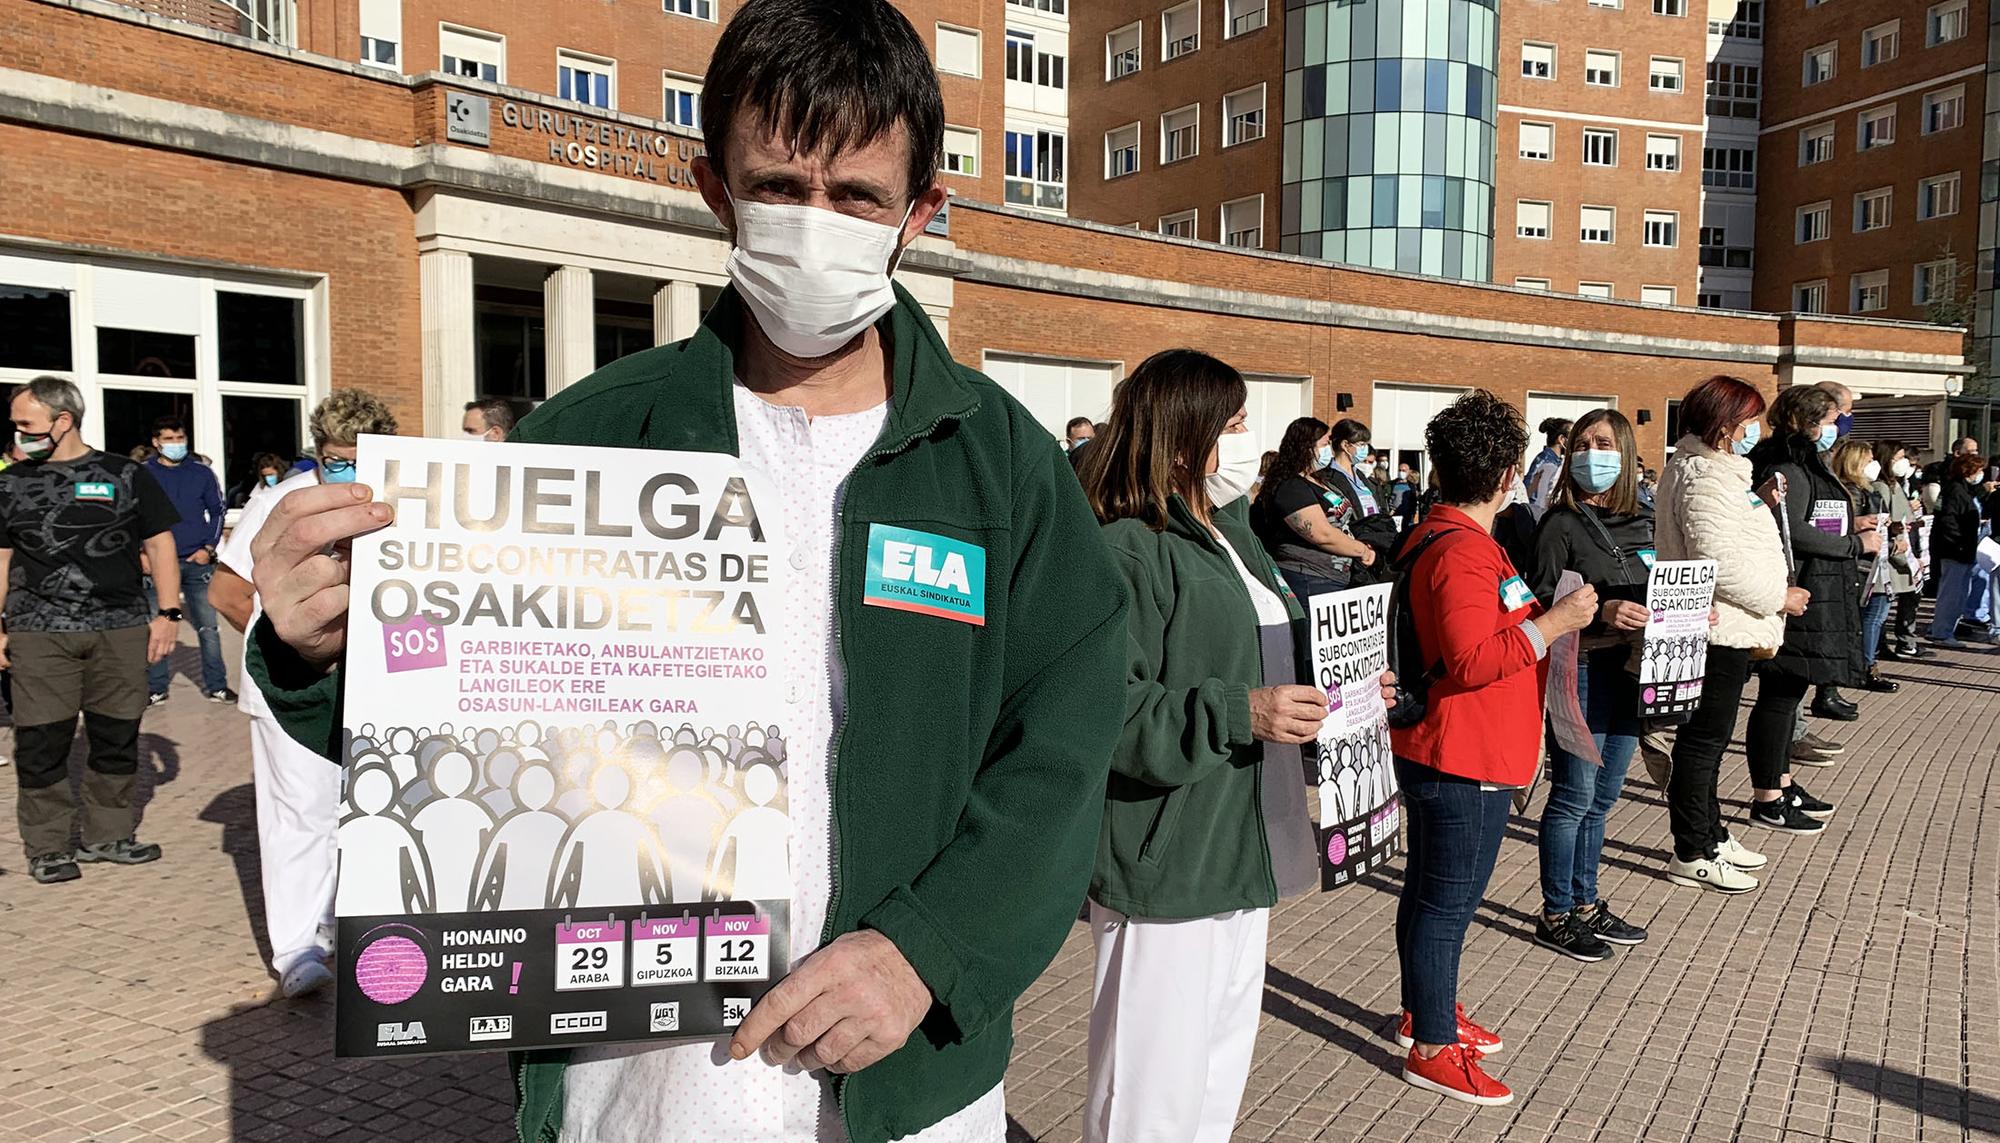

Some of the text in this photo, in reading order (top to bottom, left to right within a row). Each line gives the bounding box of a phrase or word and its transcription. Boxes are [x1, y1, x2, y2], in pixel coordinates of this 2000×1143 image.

[502, 103, 669, 157] GURUTZETAKO
[550, 139, 656, 180] HOSPITAL
[384, 460, 766, 542] HUELGA
[378, 540, 768, 583] SUBCONTRATAS DE
[882, 539, 971, 595] ELA
[1654, 565, 1714, 585] HUELGA
[881, 583, 971, 608] EUSKAL SINDIKATUA
[1652, 586, 1706, 597] SUBCONTRATAS
[371, 579, 766, 634] OSAKIDETZA
[1651, 596, 1710, 611] OSAKIDETZA
[1317, 595, 1384, 642] HUELGA
[390, 625, 439, 657] SOS
[460, 640, 764, 661] GARBIKETAKO, ANBULANTZIETAKO
[1319, 632, 1377, 663] SUBCONTRATAS
[460, 659, 767, 679] ETA SUKALDE ETA KAFETEGIETAKO
[1321, 649, 1385, 690] OSAKIDETZA
[459, 678, 606, 693] LANGILEOK ERE
[458, 697, 698, 713] OSASUN-LANGILEAK GARA
[1328, 687, 1340, 705] SOS
[576, 928, 602, 939] OCT
[652, 924, 677, 936] NOV
[724, 921, 749, 932] NOV
[442, 928, 526, 946] HONAINO
[442, 952, 504, 969] HELDU
[571, 947, 608, 970] 29
[655, 943, 672, 965] 5
[719, 940, 755, 962] 12
[570, 973, 610, 984] ARABA
[637, 968, 693, 980] GIPUZKOA
[715, 966, 759, 975] BIZKAIA
[441, 976, 493, 993] GARA
[555, 1016, 603, 1029] CCOO
[655, 1007, 674, 1019] UGT
[377, 1021, 427, 1041] ELA
[472, 1018, 510, 1034] LAB
